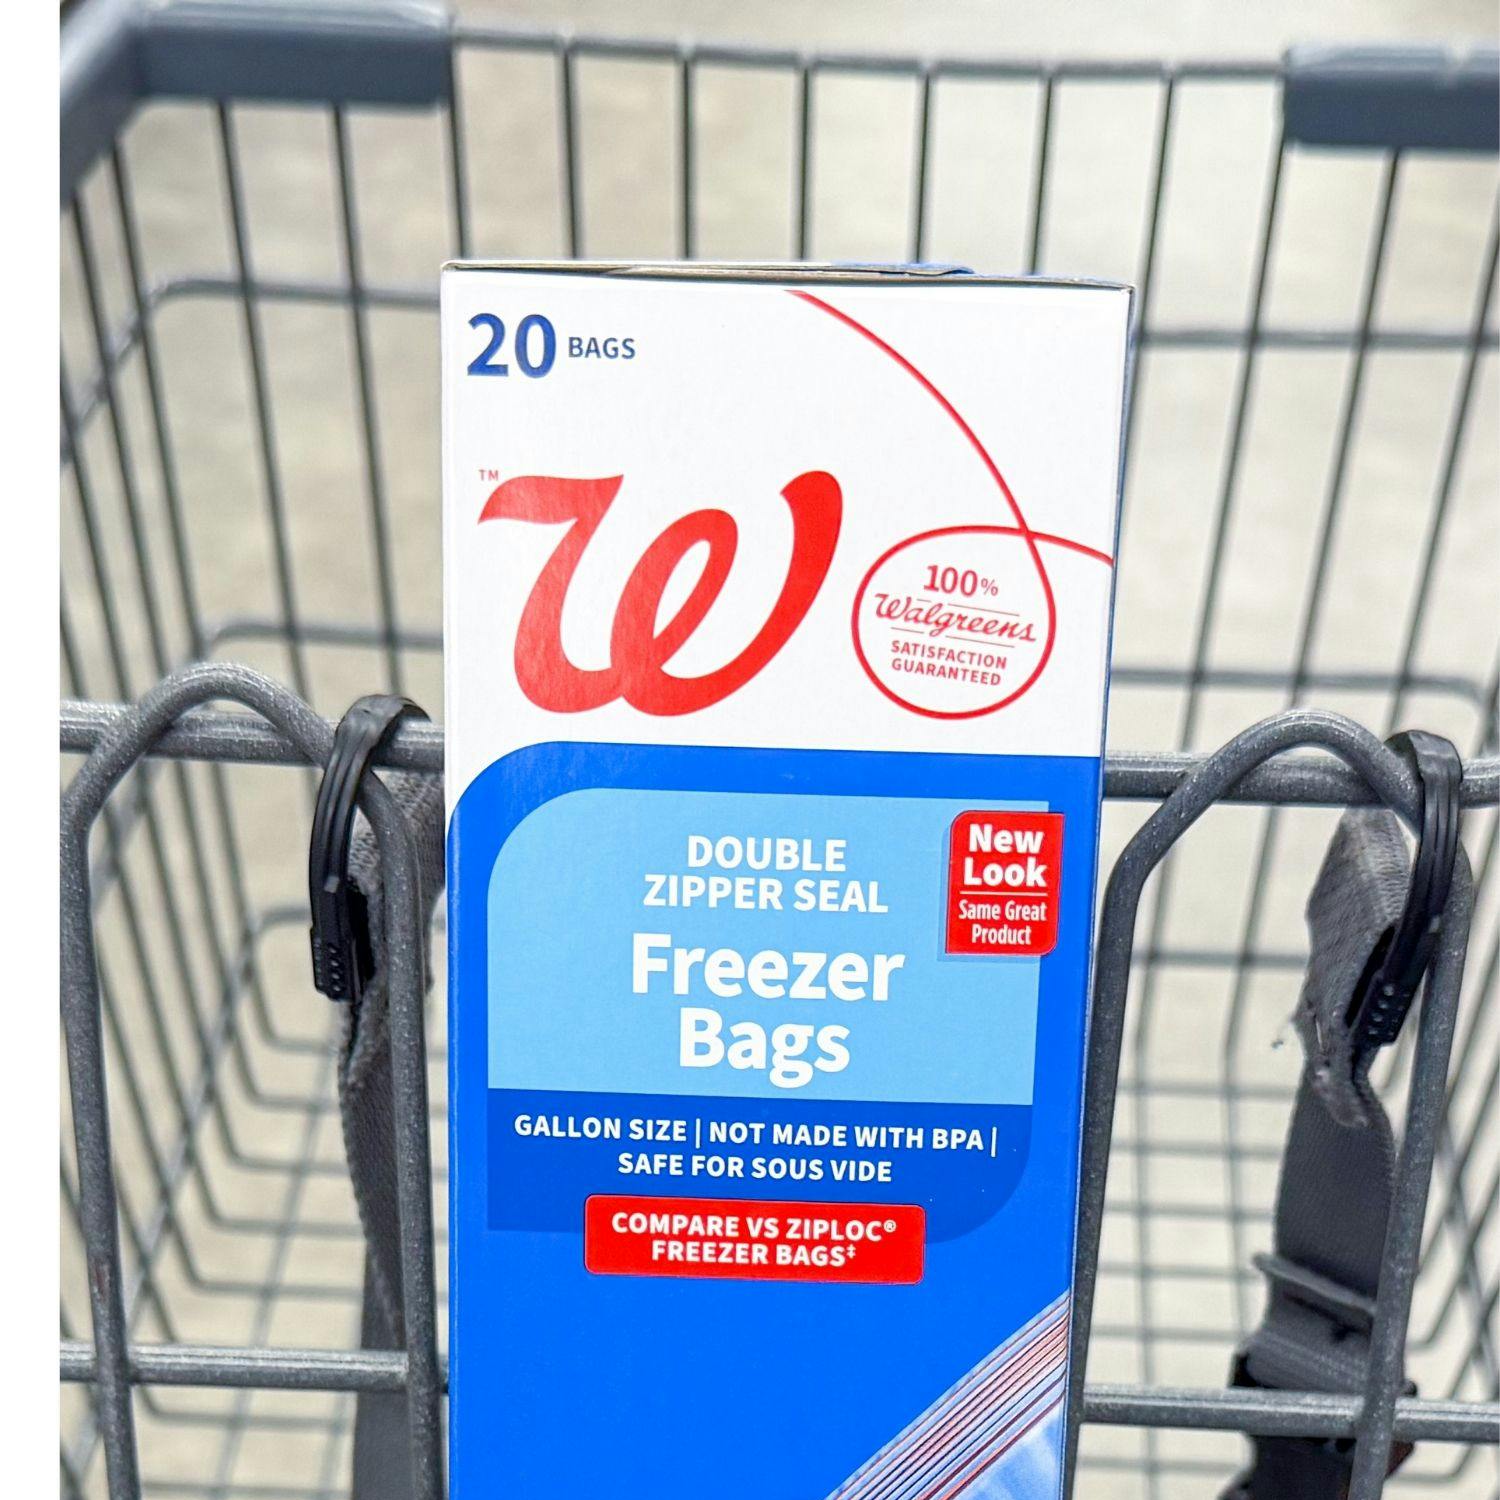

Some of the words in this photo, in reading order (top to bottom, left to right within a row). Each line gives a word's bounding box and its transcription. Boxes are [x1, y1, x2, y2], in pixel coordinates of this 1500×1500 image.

[466, 312, 557, 378] 20
[568, 336, 635, 359] BAGS
[924, 565, 998, 597] 100%
[875, 593, 1036, 642] Walgreens
[891, 641, 1007, 669] SATISFACTION
[892, 659, 1001, 686] GUARANTEED
[688, 835, 846, 872] DOUBLE
[969, 824, 1044, 854] New
[964, 858, 1048, 888] Look
[644, 875, 782, 910] ZIPPER
[794, 878, 888, 913] SEAL
[959, 900, 1000, 920] Same
[1004, 902, 1046, 922] Great
[972, 924, 1031, 945] Product
[632, 932, 905, 1001] Freezer
[679, 1008, 850, 1088] Bags
[515, 1115, 622, 1140] GALLON
[629, 1119, 687, 1142] SIZE
[709, 1122, 766, 1145] NOT
[772, 1124, 846, 1147] MADE
[854, 1126, 924, 1149] WITH
[932, 1128, 984, 1150] BPA
[618, 1152, 682, 1176] SAFE
[752, 1158, 823, 1181] SOUS
[830, 1160, 892, 1182] VIDE
[612, 1212, 739, 1236] COMPARE
[652, 1240, 768, 1264] FREEZER
